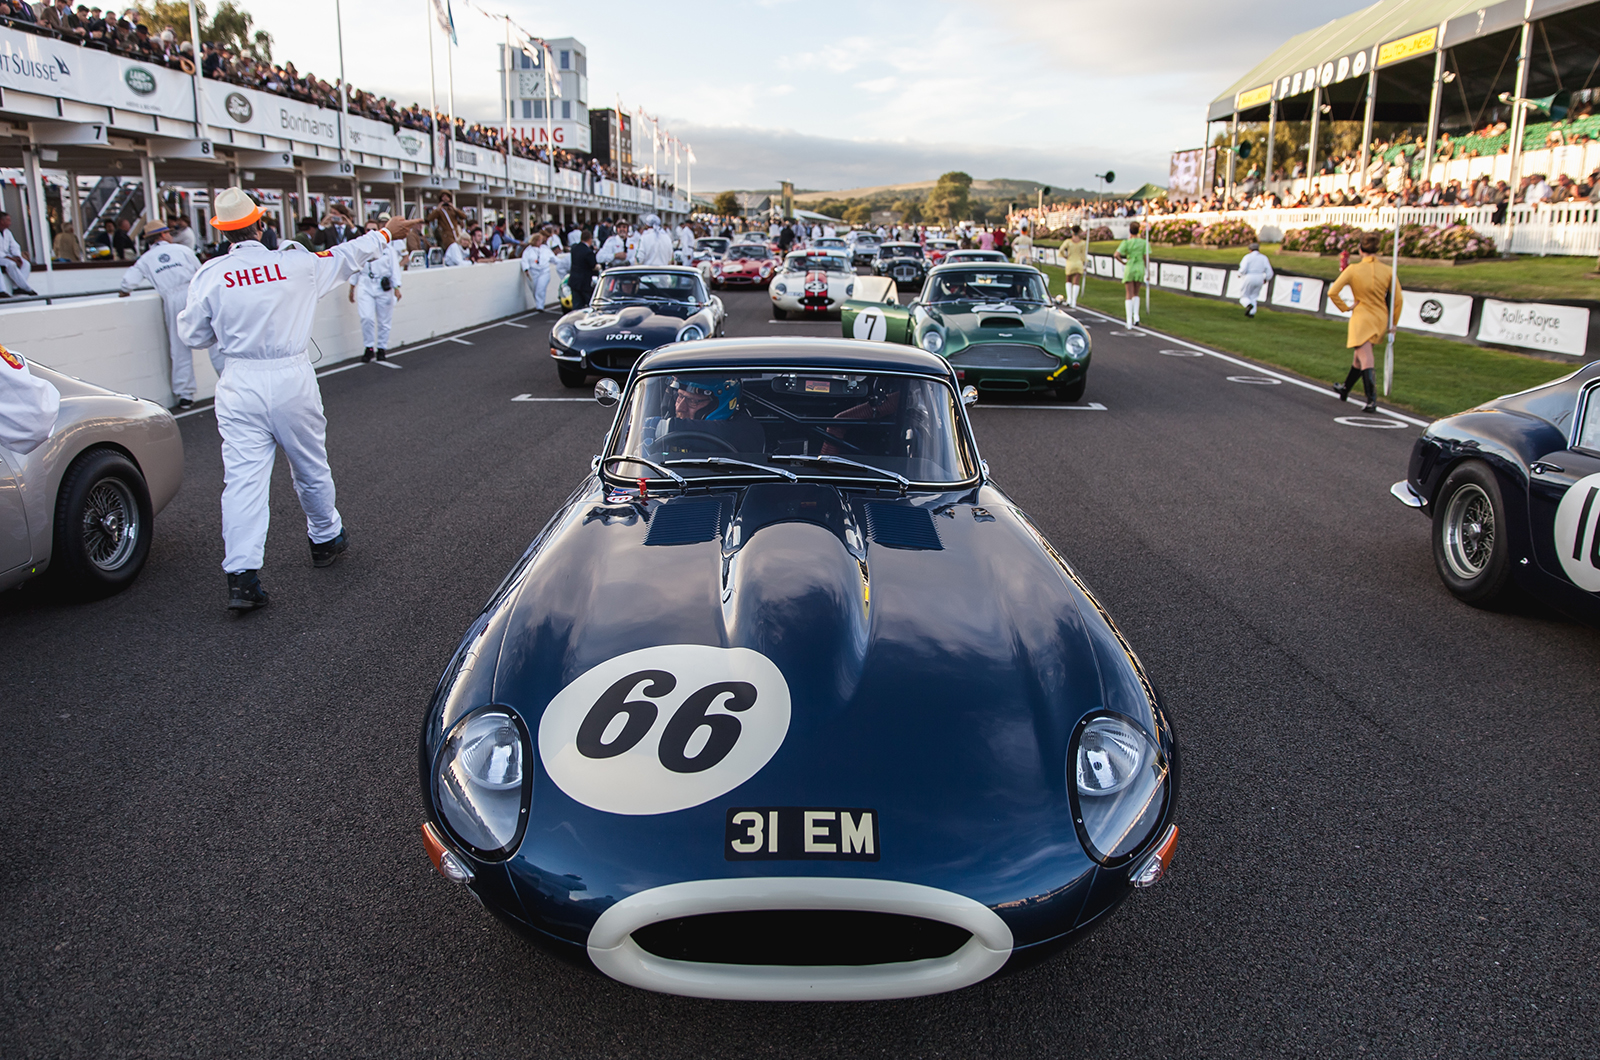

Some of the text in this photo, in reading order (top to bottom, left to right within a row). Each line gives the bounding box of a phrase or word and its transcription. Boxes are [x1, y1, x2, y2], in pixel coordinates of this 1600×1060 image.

[12, 53, 58, 82] SUISSE
[1279, 51, 1367, 100] FERODO
[228, 95, 250, 117] Ford
[93, 125, 102, 140] 7
[280, 108, 334, 139] Bonhams
[201, 141, 210, 154] 8
[282, 153, 290, 164] 9
[340, 162, 351, 174] 10
[223, 263, 287, 289] SHELL
[806, 281, 826, 291] 23
[1420, 302, 1441, 319] Ford
[1501, 306, 1561, 331] Rolls-Royce
[605, 334, 643, 342] 170FPX
[864, 314, 878, 341] 7
[576, 669, 758, 774] 66
[731, 811, 875, 854] 31 EM
